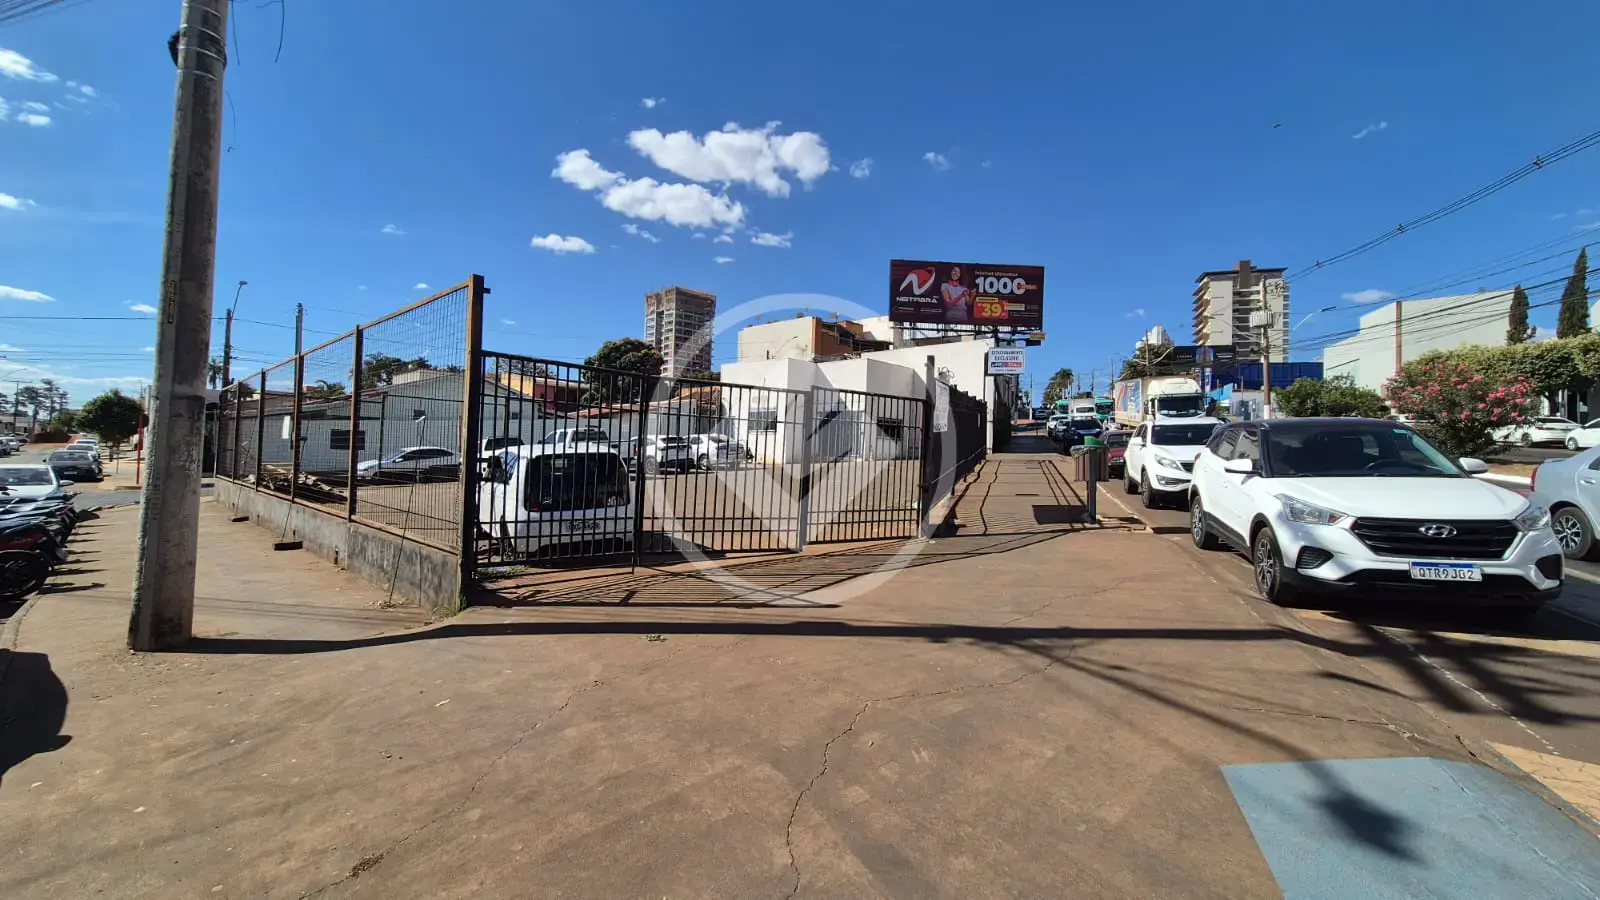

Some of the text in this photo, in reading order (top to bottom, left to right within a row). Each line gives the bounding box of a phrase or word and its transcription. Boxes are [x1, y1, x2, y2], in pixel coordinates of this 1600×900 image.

[975, 276, 1026, 295] 1000
[982, 303, 1002, 317] 39
[1418, 567, 1474, 580] QTR9J02
